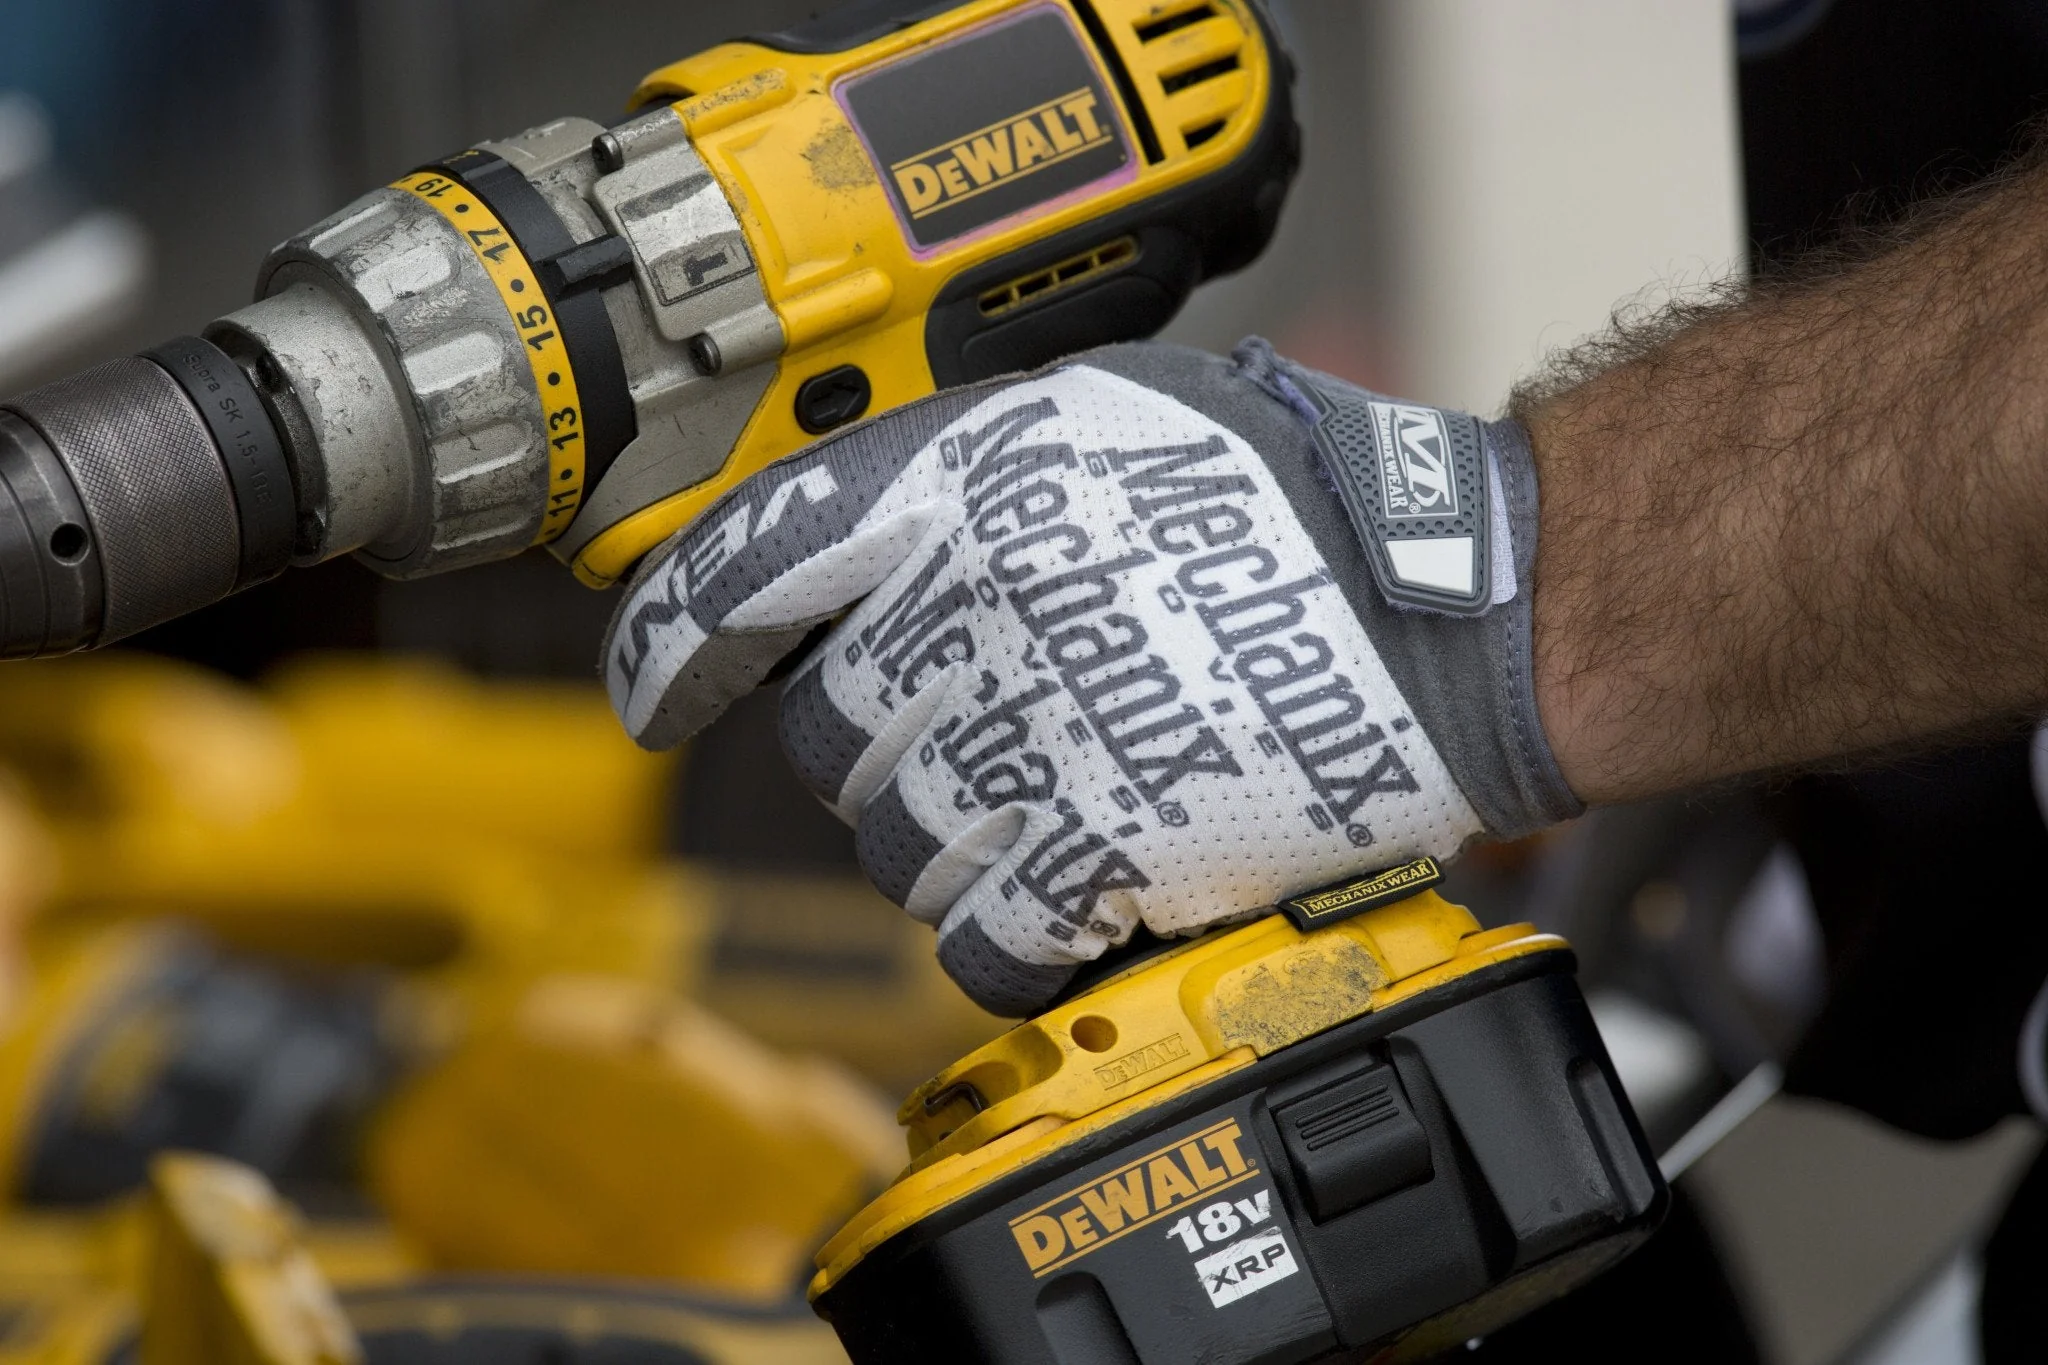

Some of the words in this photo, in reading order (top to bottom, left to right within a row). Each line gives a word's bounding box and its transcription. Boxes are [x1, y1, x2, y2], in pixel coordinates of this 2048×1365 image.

[415, 178, 453, 197] 19
[467, 228, 509, 264] 17
[516, 305, 555, 351] 15
[219, 397, 243, 423] SK
[550, 406, 578, 450] 13
[548, 488, 578, 517] 11
[1385, 460, 1408, 509] WEAR
[957, 397, 1243, 801] Mechanix
[1107, 435, 1421, 825] Mechanix
[1309, 882, 1388, 912] MECHANIX
[1387, 863, 1431, 887] WEAR
[1212, 1242, 1286, 1294] XRP
